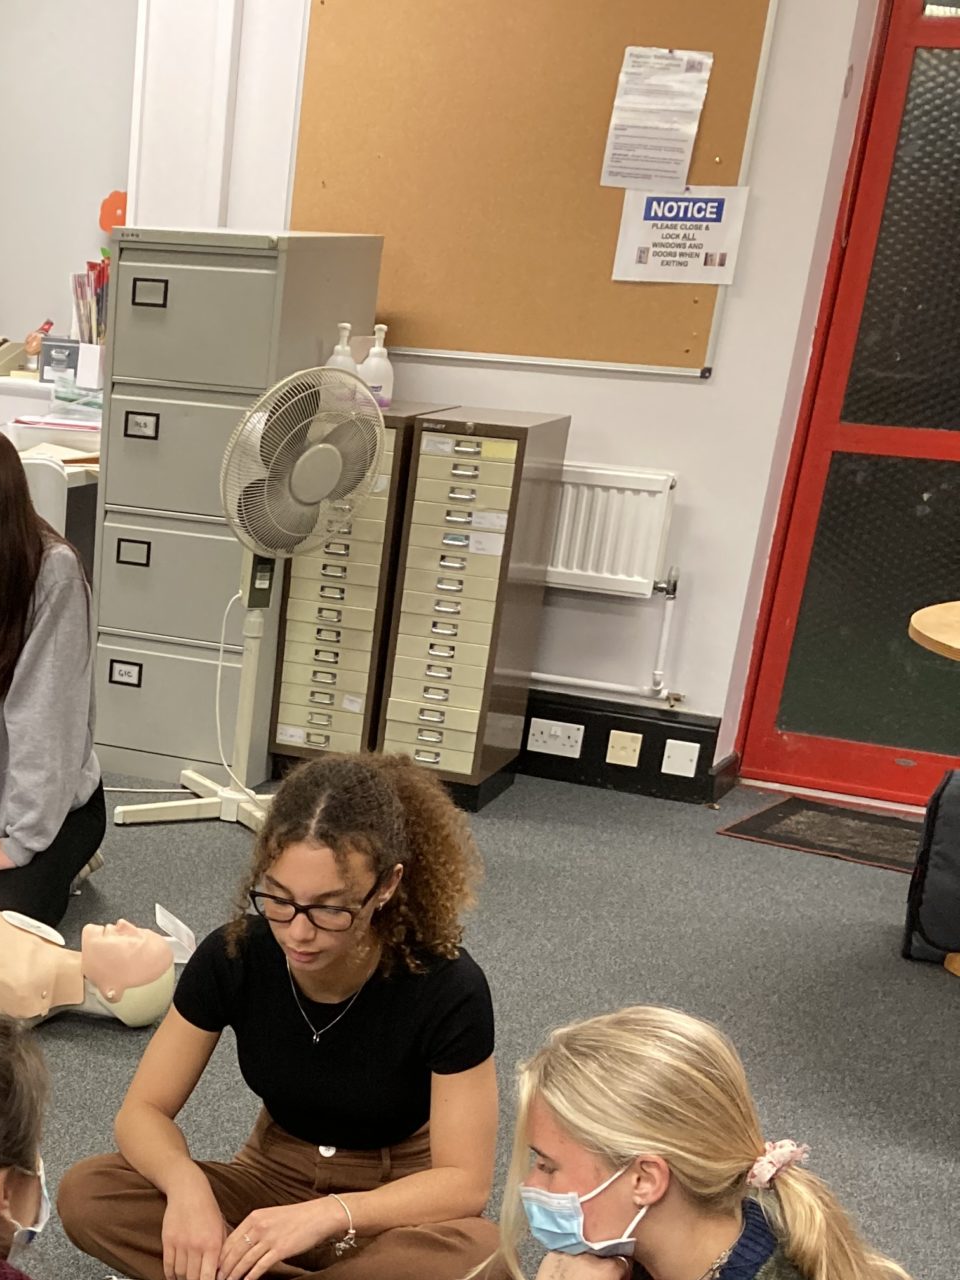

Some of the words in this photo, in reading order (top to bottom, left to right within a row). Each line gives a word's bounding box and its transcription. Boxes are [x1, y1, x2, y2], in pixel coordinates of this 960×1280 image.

[651, 200, 719, 219] NOTICE
[651, 223, 679, 231] PLEASE
[680, 223, 703, 232] CLOSE
[661, 232, 681, 240] LOCK
[682, 233, 697, 241] ALL
[651, 242, 687, 250] WINDOWS
[688, 242, 704, 250] AND
[678, 251, 700, 259] WHEN
